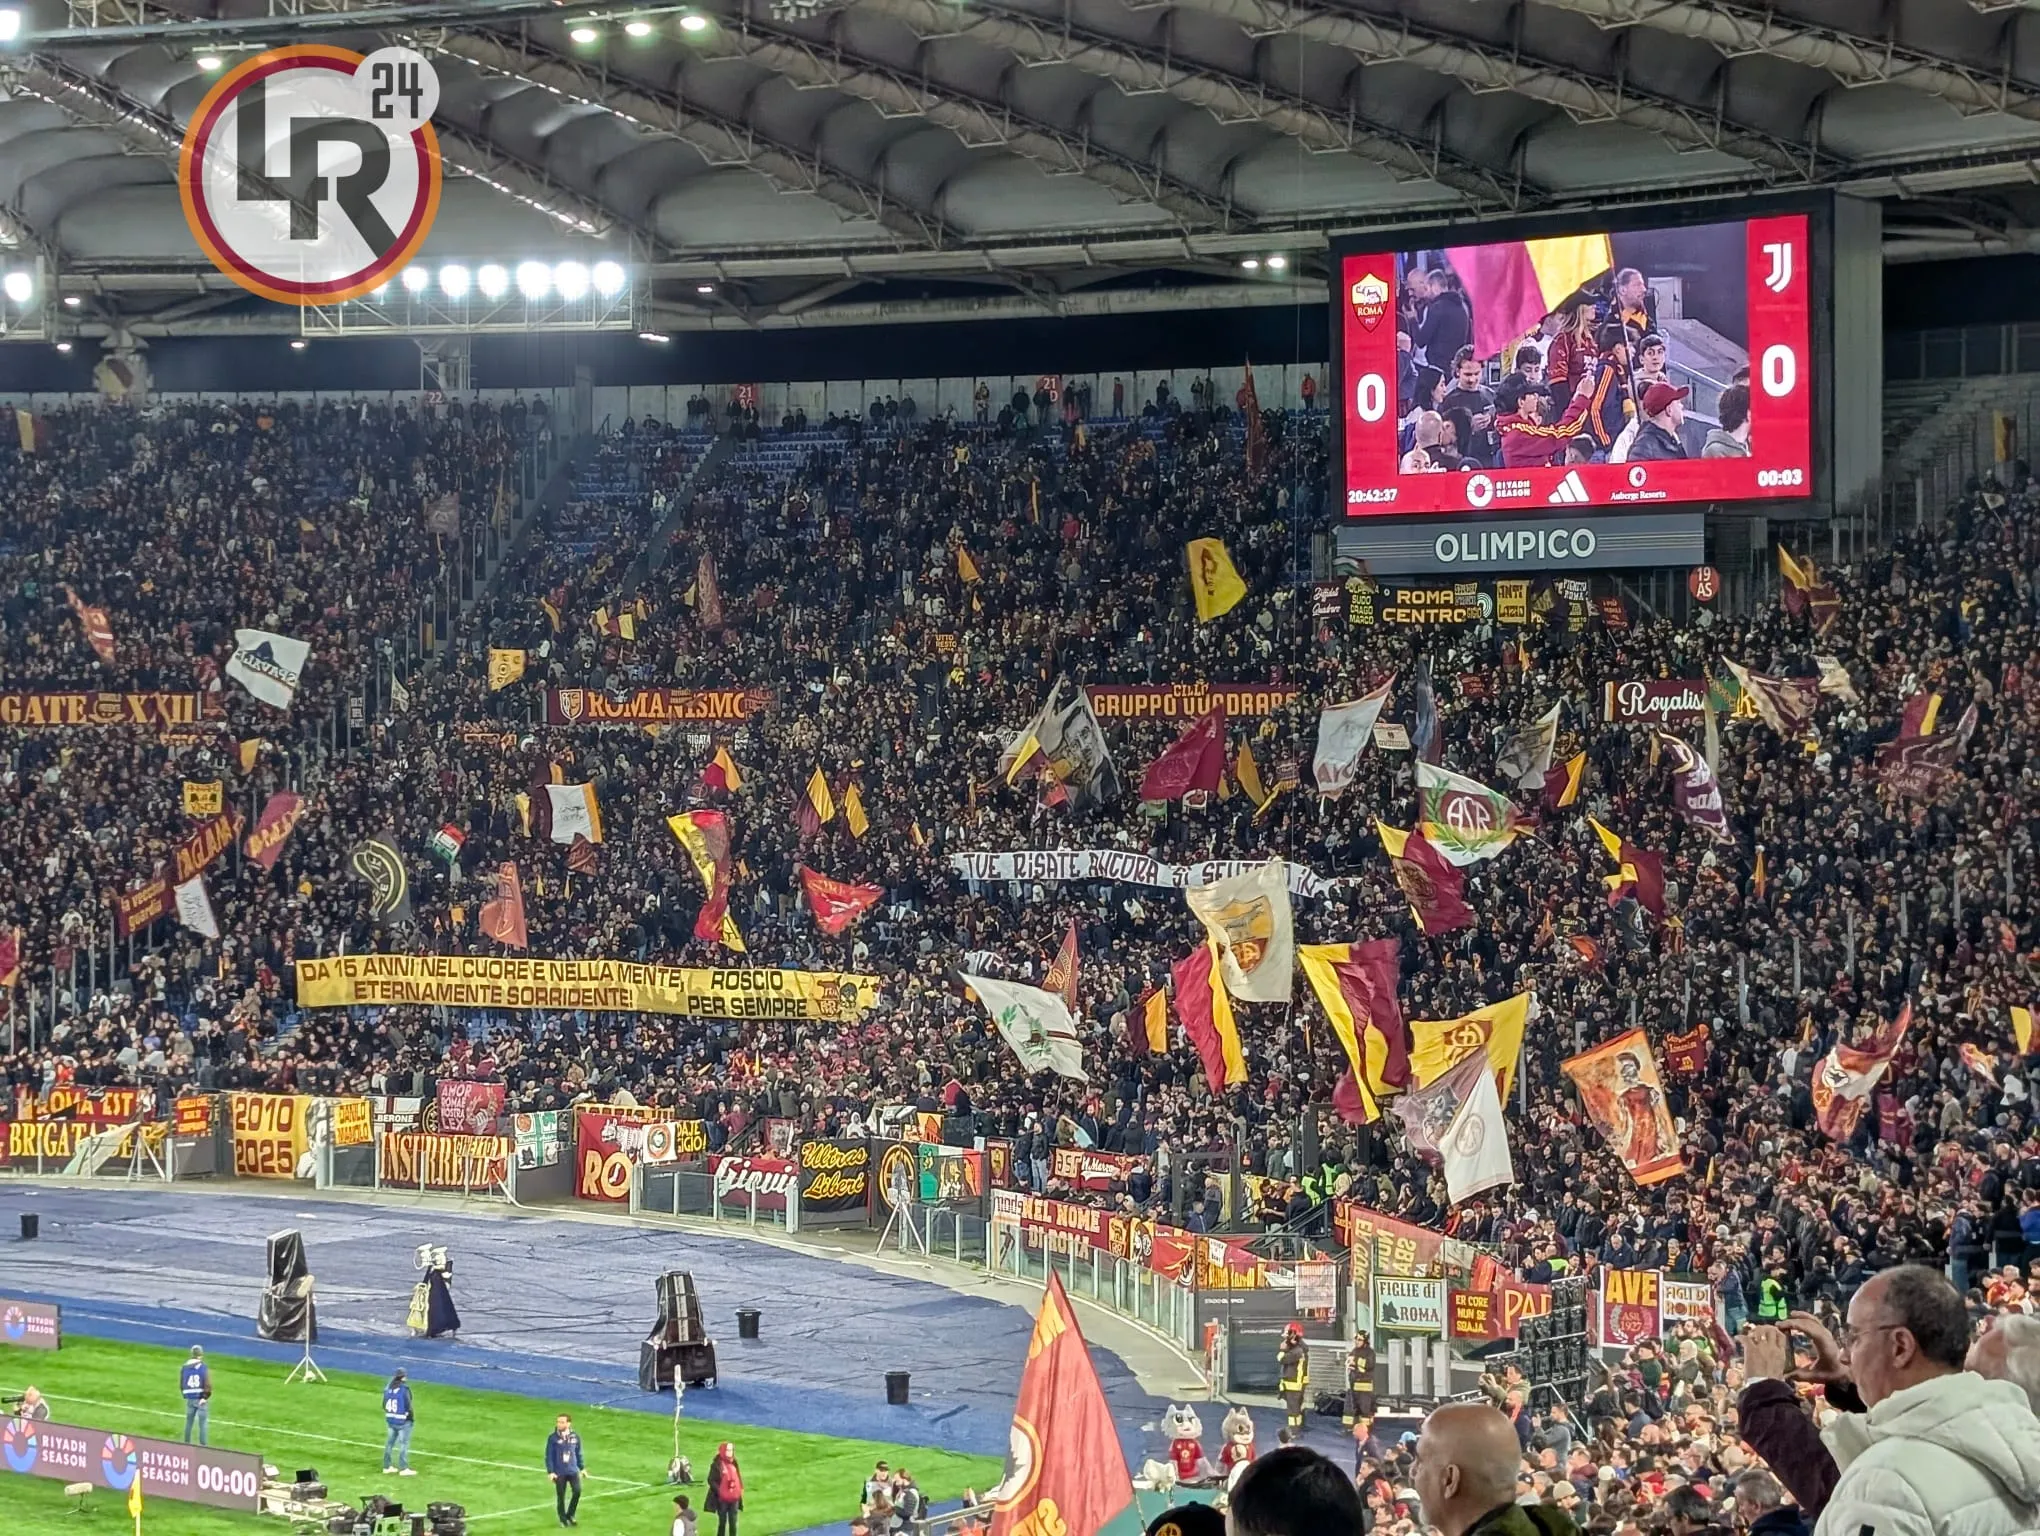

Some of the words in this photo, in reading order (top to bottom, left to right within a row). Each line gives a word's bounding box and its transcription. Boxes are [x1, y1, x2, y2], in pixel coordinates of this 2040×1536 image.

[1357, 306, 1384, 316] ROMA
[1762, 344, 1796, 397] 0
[429, 391, 444, 403] 22
[739, 386, 752, 398] 21
[1357, 373, 1387, 422] 0
[1496, 480, 1531, 489] RIYADH
[1758, 469, 1803, 487] 00:03
[1496, 489, 1531, 498] SEASON
[1611, 491, 1639, 500] Auberge
[1639, 490, 1666, 499] Resorts
[1435, 528, 1597, 562] OLIMPICO
[1697, 566, 1711, 582] 19
[1397, 590, 1454, 604] ROMA
[1696, 582, 1712, 597] AS
[1349, 614, 1375, 625] MARCO
[1382, 608, 1467, 623] CENTRO
[1, 695, 88, 725] GATE
[1094, 694, 1176, 716] GRUPPO
[963, 853, 1001, 878] TUE
[301, 962, 331, 982] DA
[335, 959, 357, 978] 15
[363, 958, 416, 977] ANNI
[420, 958, 458, 978] NEL
[462, 959, 531, 980] CUORE
[533, 961, 546, 980] E
[551, 961, 614, 982] NELLA
[711, 970, 783, 991] ROSCIO
[354, 981, 502, 1002] ETERNAMENTE
[687, 995, 726, 1015] PER
[731, 996, 808, 1018] SEMPRE
[441, 1084, 472, 1097] AMOR
[102, 1092, 134, 1117] EST
[235, 1097, 293, 1132] 2010
[376, 1114, 414, 1123] BERONE
[443, 1117, 464, 1131] LEX
[235, 1140, 293, 1174] 2025
[801, 1142, 868, 1169] Ultras
[802, 1170, 865, 1200] Liberi
[1021, 1197, 1052, 1223] NEL
[1056, 1203, 1101, 1233] NOME
[1379, 1281, 1420, 1298] FIGLIE
[1423, 1283, 1437, 1298] di
[1605, 1270, 1658, 1307] AVE
[1664, 1285, 1693, 1300] FIGLI
[1455, 1294, 1467, 1306] ER
[1468, 1296, 1489, 1307] CORE
[27, 1315, 54, 1326] RIYADH
[1400, 1306, 1440, 1322] ROMA
[1476, 1309, 1487, 1320] SE
[27, 1325, 54, 1335] SEASON
[1620, 1321, 1642, 1332] 1927
[42, 1435, 87, 1454] RIYADH
[42, 1451, 87, 1469] SEASON
[142, 1452, 189, 1469] RIYADH
[142, 1466, 189, 1486] SEASON
[198, 1464, 257, 1497] 00:00
